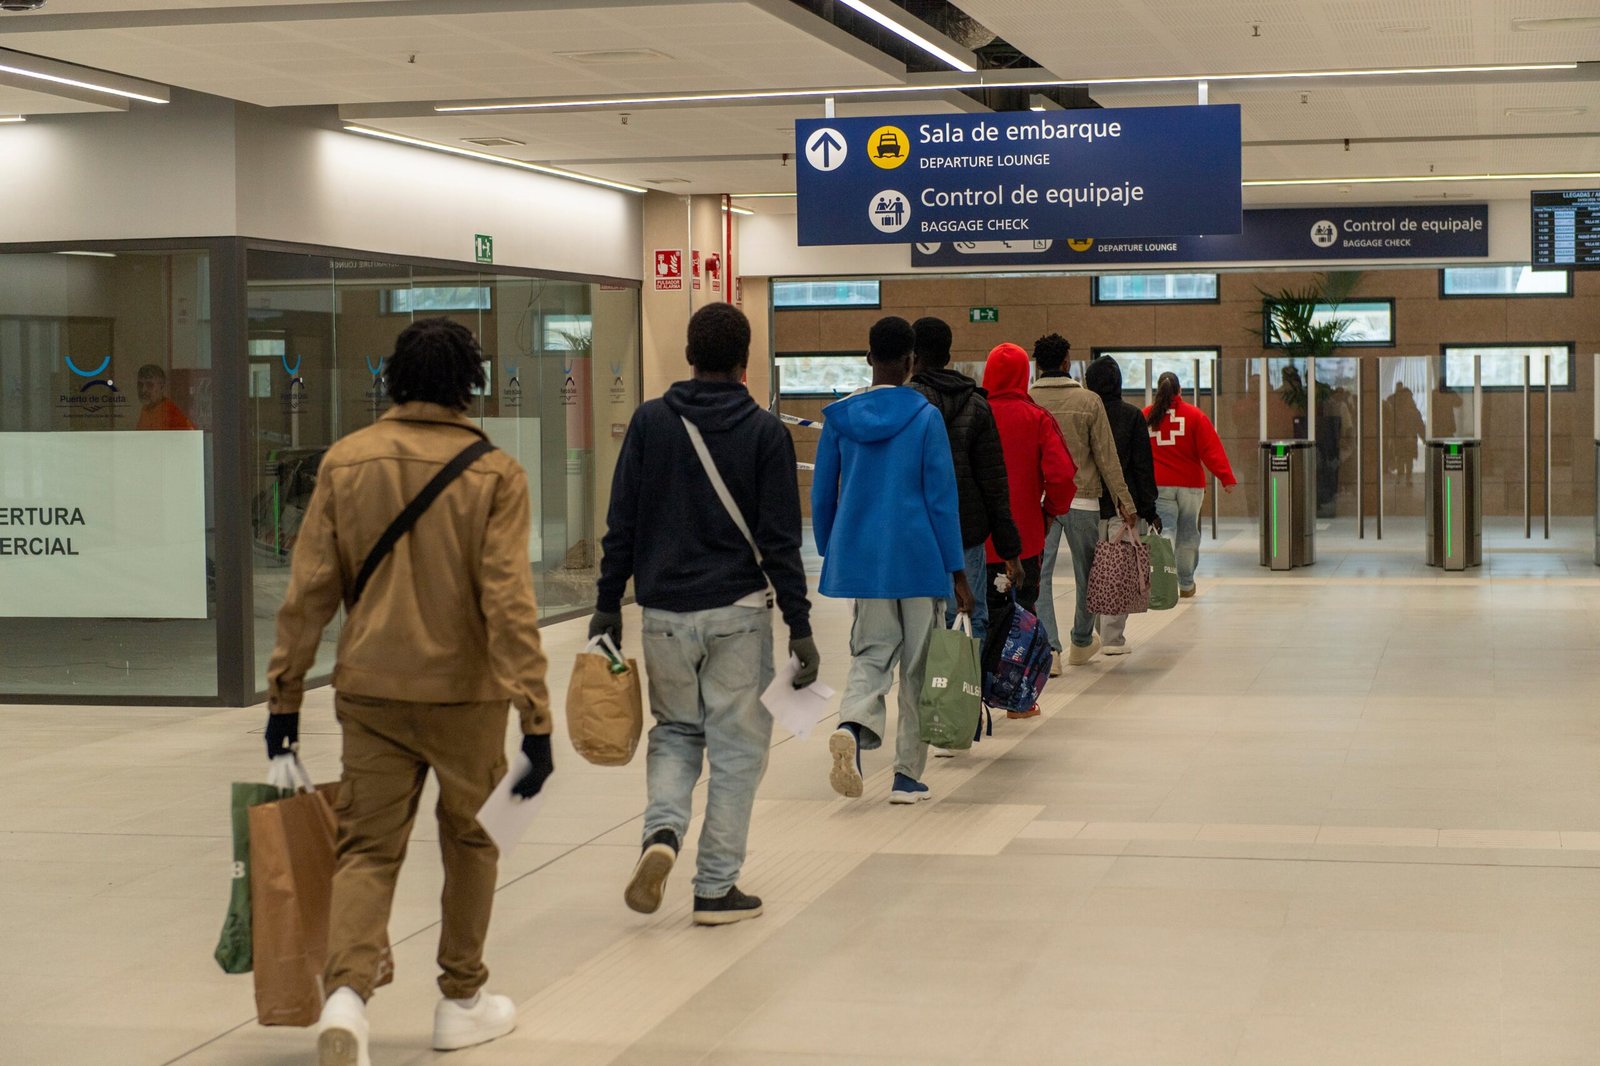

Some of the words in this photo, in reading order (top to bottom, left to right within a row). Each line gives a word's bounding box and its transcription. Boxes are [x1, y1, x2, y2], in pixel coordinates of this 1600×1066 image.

[919, 123, 964, 143] Sala
[971, 121, 999, 142] de
[1006, 119, 1122, 143] embarque
[919, 155, 994, 169] DEPARTURE
[997, 153, 1050, 167] LOUNGE
[921, 184, 1003, 207] Control
[1011, 184, 1039, 205] de
[1045, 181, 1144, 207] equipaje
[921, 219, 984, 232] BAGGAGE
[987, 218, 1029, 231] CHECK
[1343, 217, 1396, 232] Control
[1399, 217, 1418, 231] de
[1421, 216, 1483, 234] equipaje
[1098, 243, 1143, 252] DEPARTURE
[1144, 243, 1177, 251] LOUNGE
[1343, 239, 1382, 247] BAGGAGE
[1384, 238, 1411, 247] CHECK
[60, 395, 87, 403] Puerto
[89, 394, 99, 403] de
[102, 395, 127, 403] Ceuta
[0, 537, 80, 556] ERCIAL
